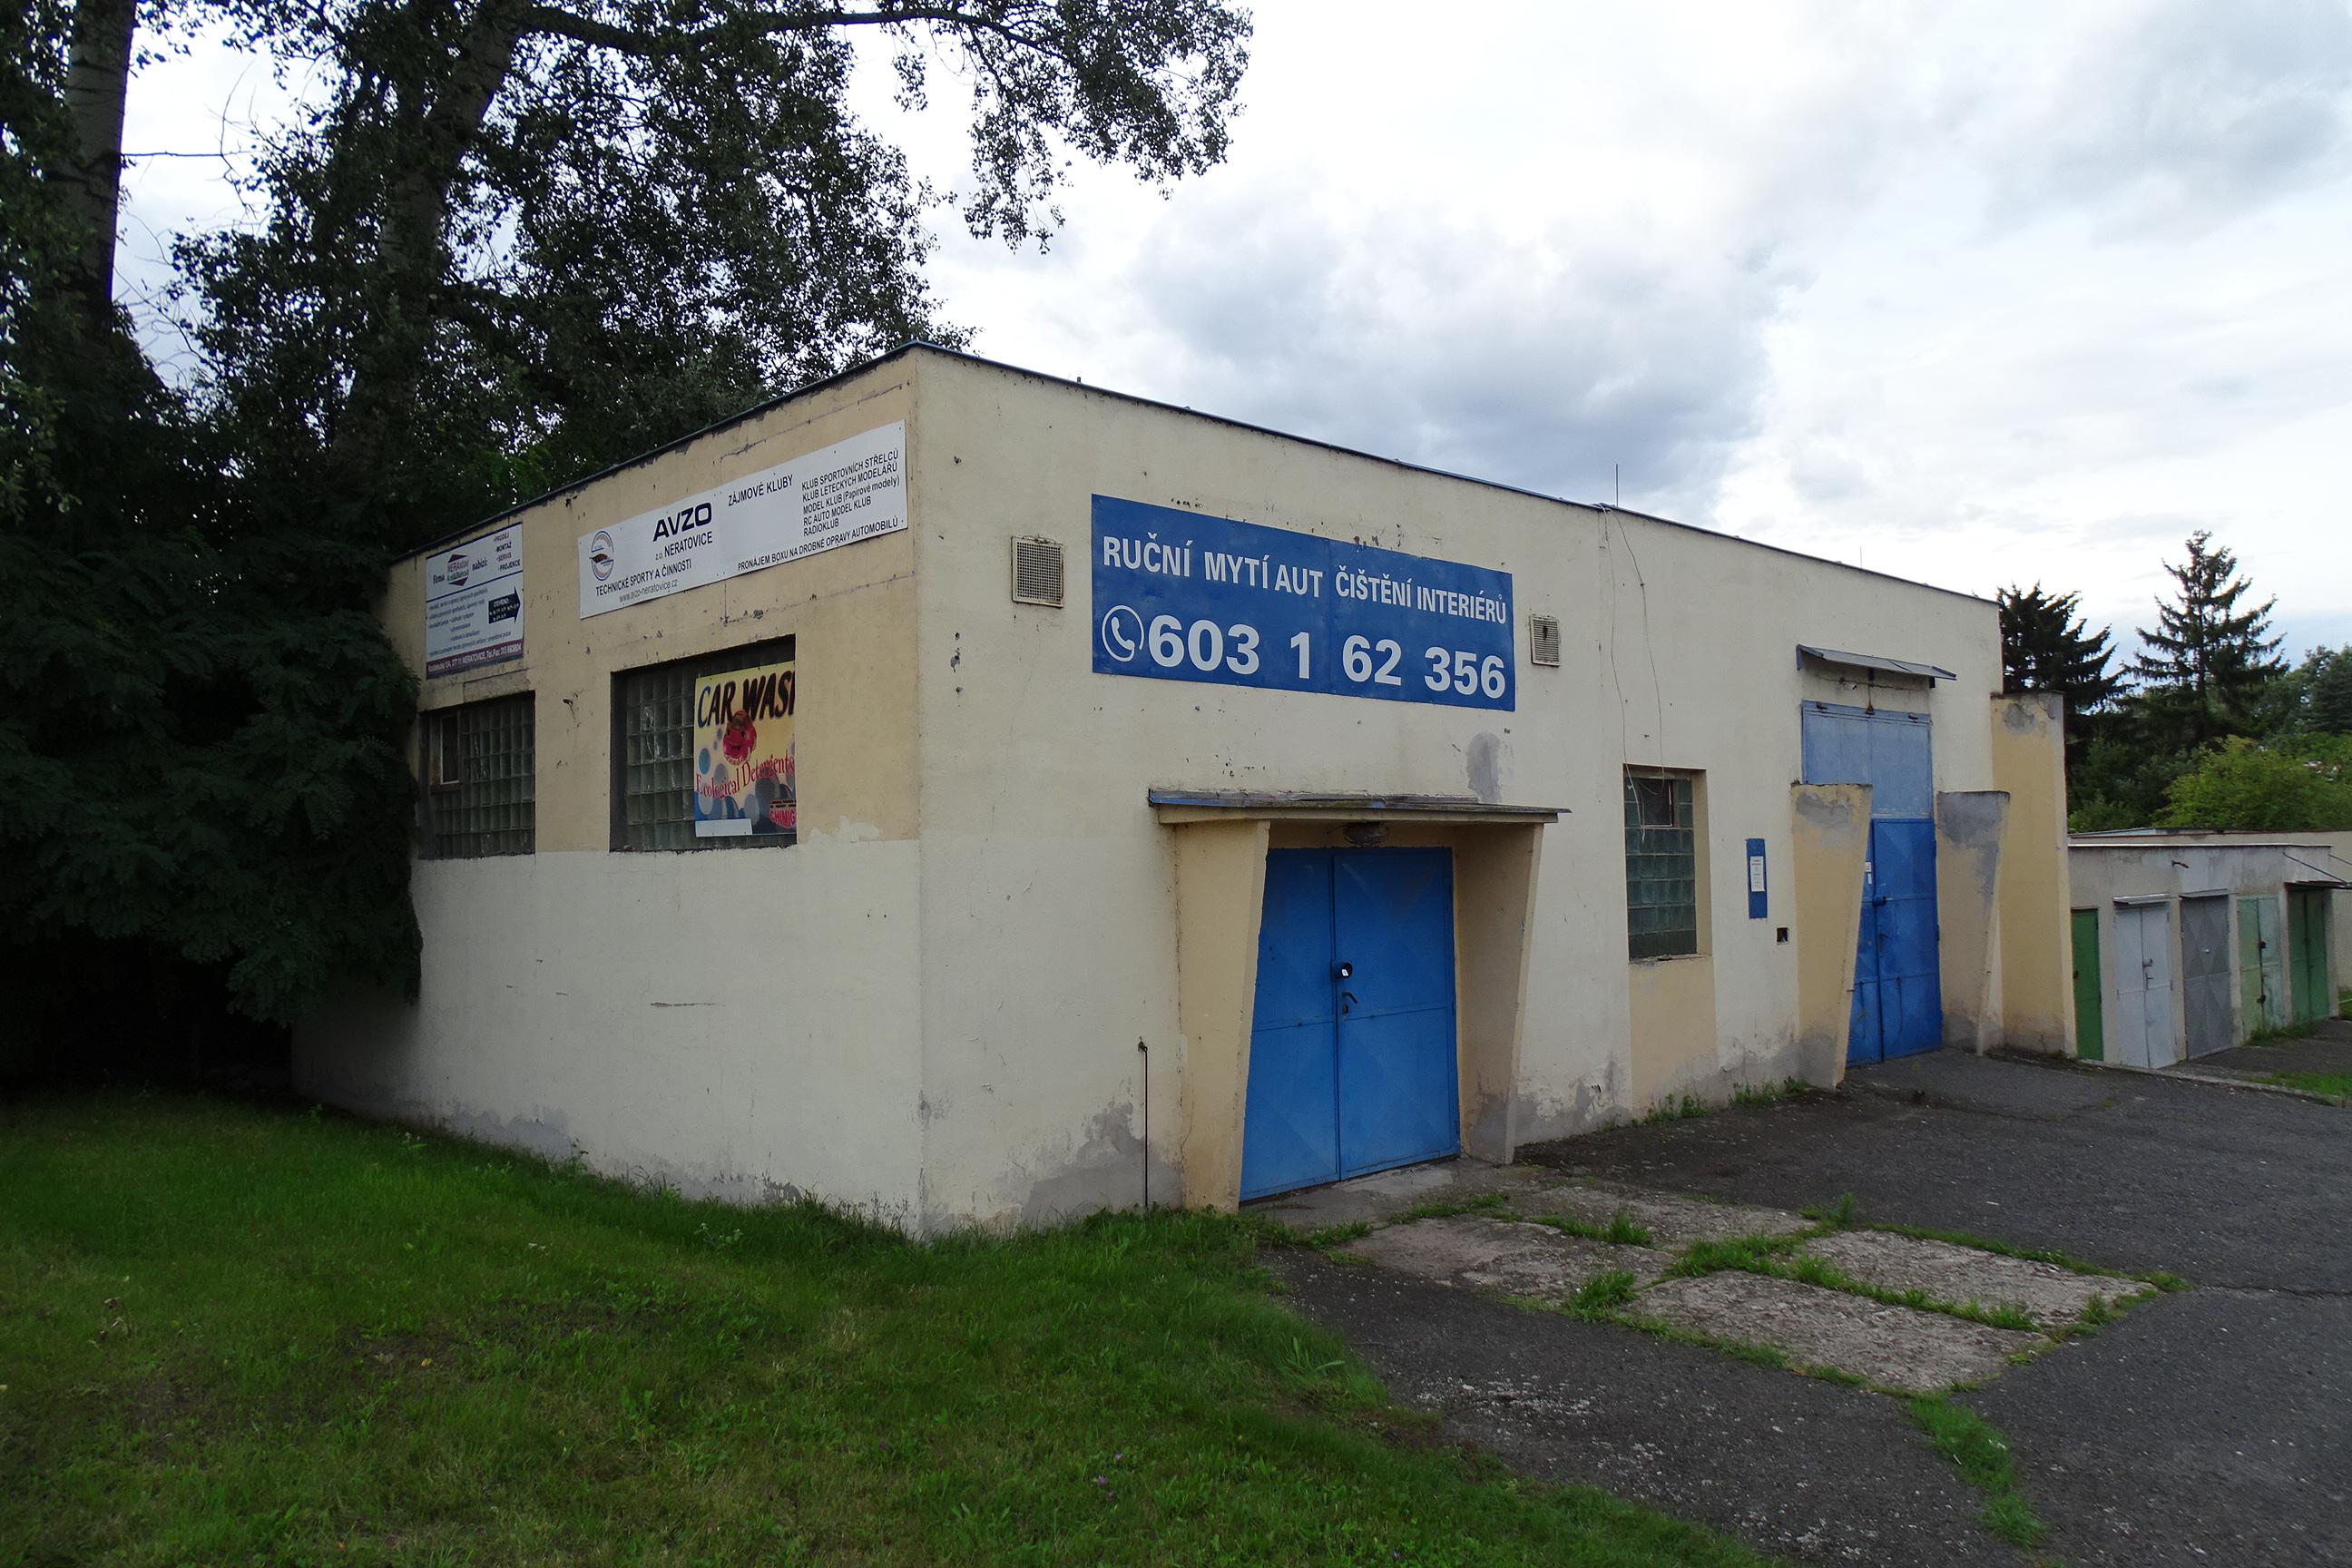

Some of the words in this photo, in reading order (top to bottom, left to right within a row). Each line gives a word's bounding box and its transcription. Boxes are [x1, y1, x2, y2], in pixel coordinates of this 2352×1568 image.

[728, 482, 764, 506] ZÁJMOVÉ
[766, 474, 793, 494] KLUBY
[802, 477, 818, 491] KLUB
[820, 461, 864, 484] SPORTOVNÍCH
[865, 448, 898, 468] STŘELCŮ
[802, 490, 819, 503] KLUB
[820, 475, 857, 495] LETECKÝCH
[858, 461, 897, 482] MODELÁŘŮ
[803, 502, 824, 514] MODEL
[826, 494, 842, 507] KLUB
[872, 475, 899, 492] modely)
[803, 515, 812, 526] RC
[813, 510, 830, 524] AUTO
[831, 503, 853, 517] MODEL
[854, 495, 871, 510] KLUB
[652, 502, 712, 542] AVZO
[804, 518, 839, 536] RADIOKLUB
[664, 531, 712, 557] NERATOVICE
[738, 554, 770, 571] PRONÁJEM
[772, 550, 789, 562] BOXU
[789, 547, 798, 556] NA
[799, 538, 824, 554] DROBNÉ
[826, 531, 850, 546] OPRAVY
[851, 516, 898, 539] AUTOMOBILŮ
[596, 577, 629, 596] TECHNICKÉ
[630, 570, 654, 585] SPORTY
[655, 570, 661, 578] A
[662, 559, 692, 577] ČINNOSTI
[1103, 533, 1192, 577] RUČNÍ
[1204, 552, 1269, 588] MYTÍ
[1274, 564, 1323, 598] AUT
[1336, 564, 1412, 608] ČIŠTĚNÍ
[1416, 585, 1507, 624] INTERIÉRŮ
[1148, 614, 1260, 675] 603
[1289, 632, 1310, 679] 1
[1342, 634, 1402, 686] 62
[1424, 646, 1506, 699] 356
[697, 681, 737, 728] CAR
[696, 772, 740, 800] Ecological
[742, 750, 795, 788] Detergents
